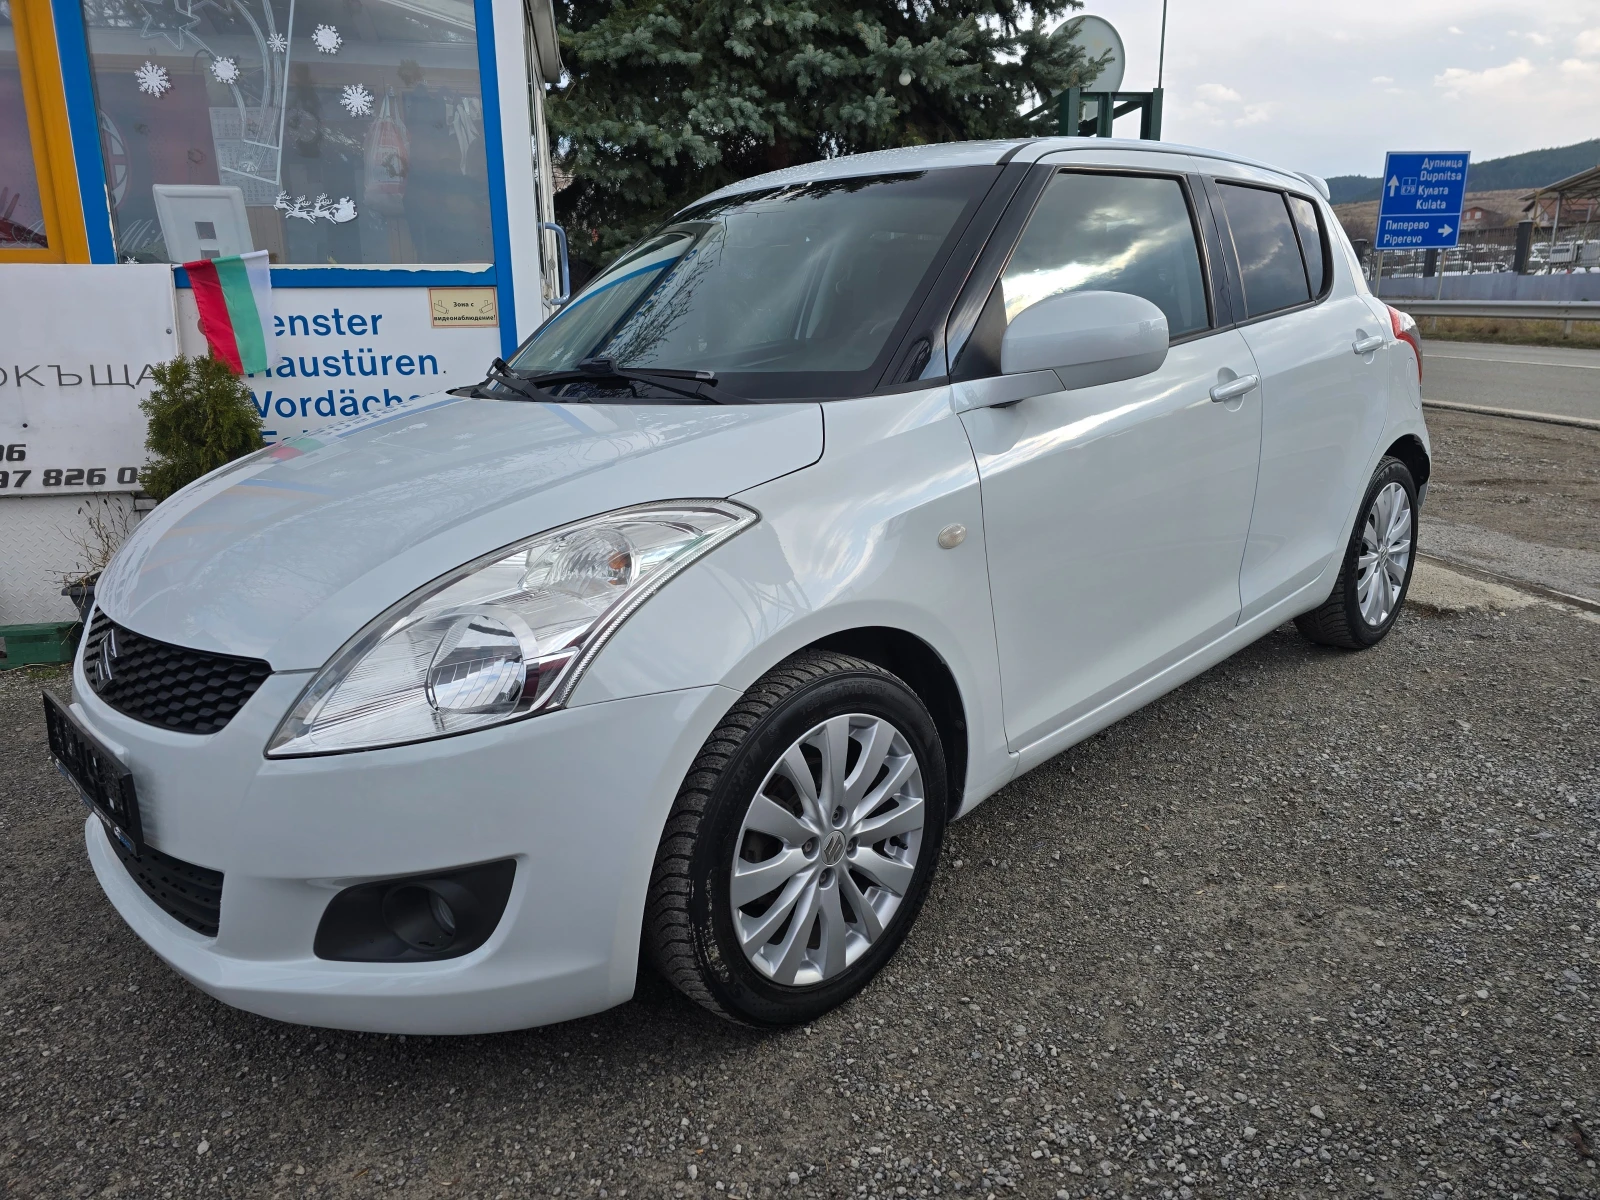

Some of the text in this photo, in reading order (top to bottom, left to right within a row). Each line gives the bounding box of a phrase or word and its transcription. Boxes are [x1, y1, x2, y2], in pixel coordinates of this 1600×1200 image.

[1421, 157, 1463, 171] Дупница
[1420, 170, 1462, 183] Dupnitsa
[1418, 185, 1448, 198] Кулата
[1416, 199, 1446, 210] Kulata
[1385, 220, 1430, 232] Пиперево
[1383, 234, 1423, 246] Piperevo
[274, 308, 382, 337] enster
[248, 347, 439, 378] austüren
[0, 363, 154, 389] КЪЩА
[0, 444, 27, 462] 6
[42, 467, 107, 487] 826
